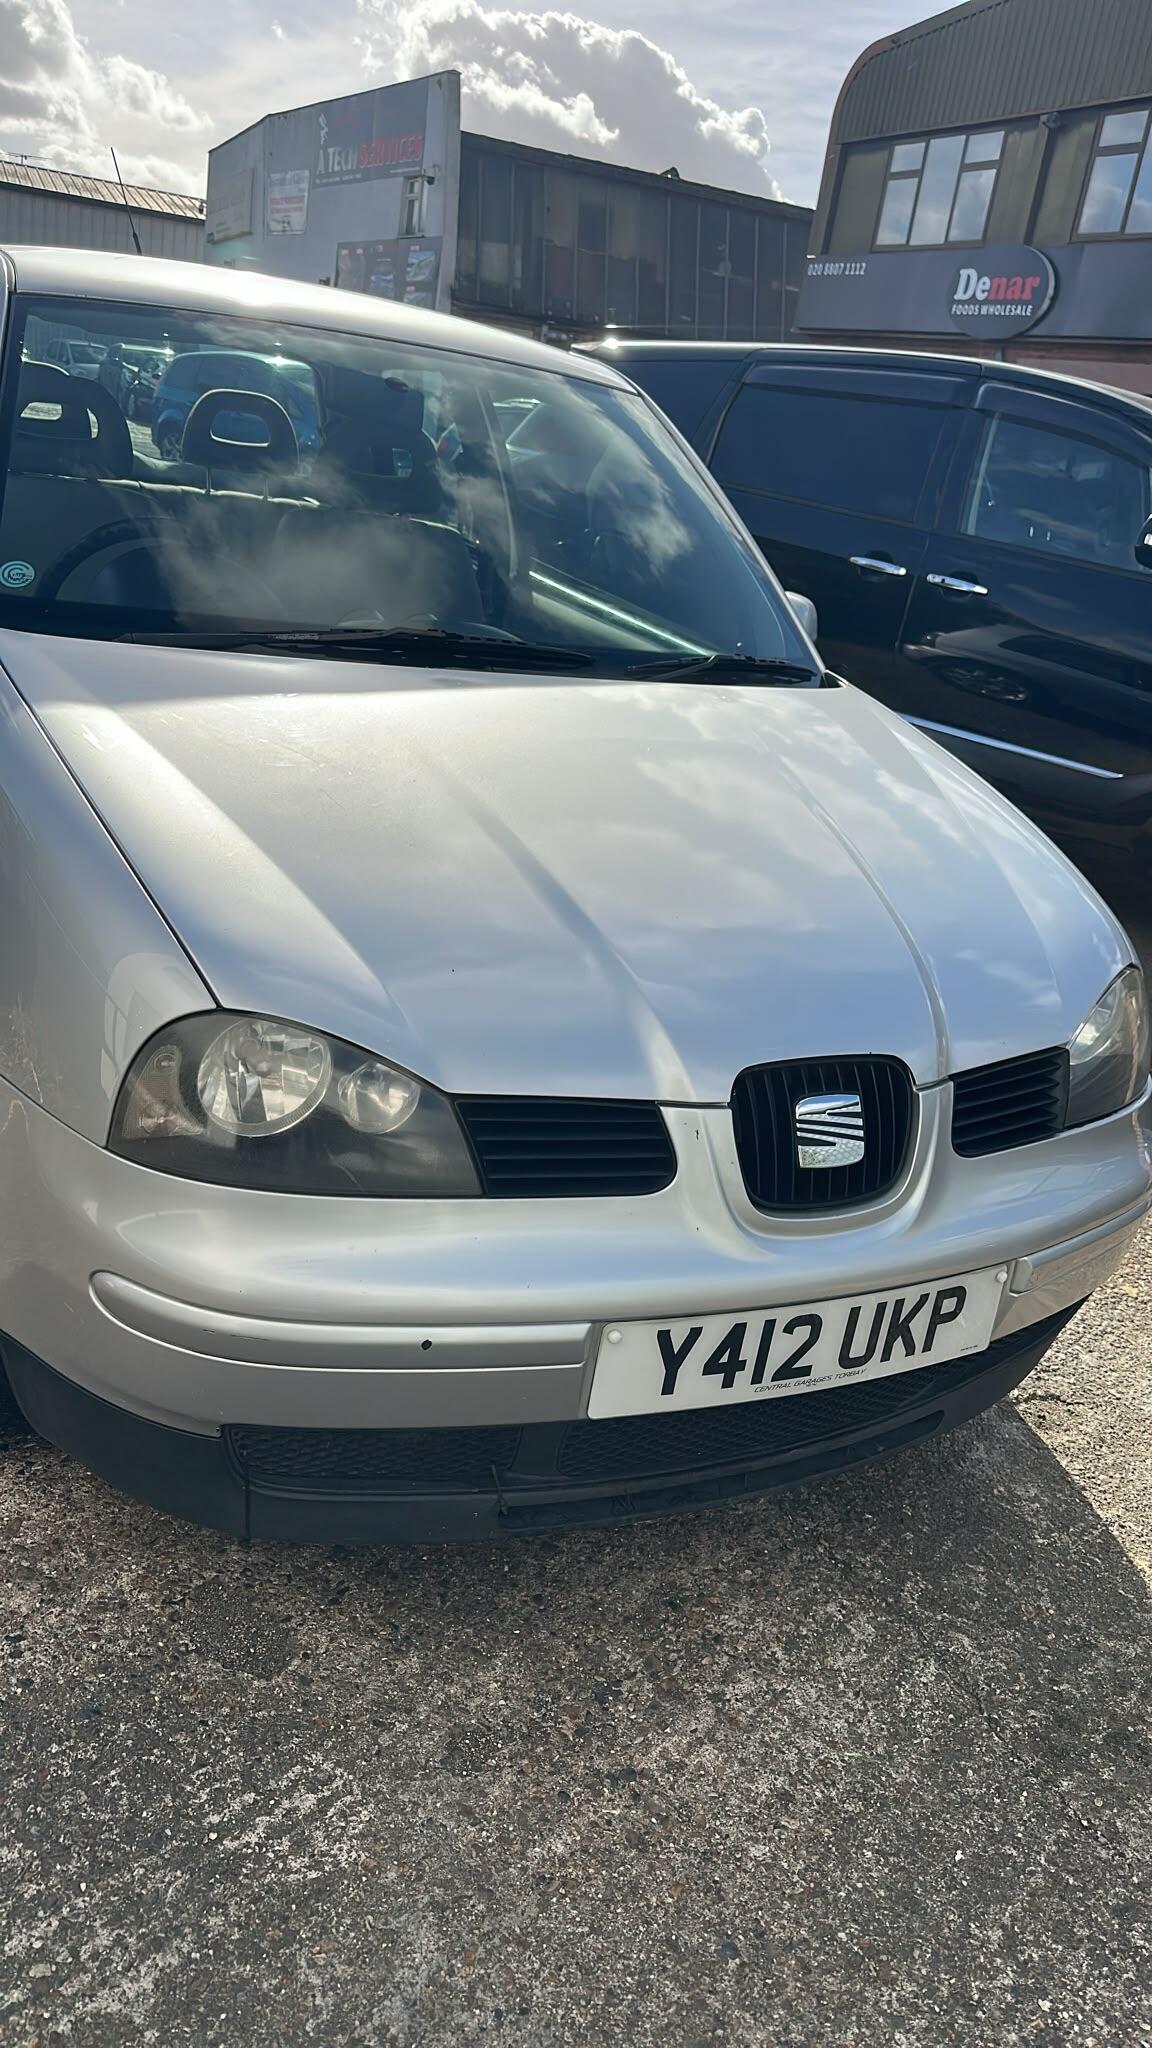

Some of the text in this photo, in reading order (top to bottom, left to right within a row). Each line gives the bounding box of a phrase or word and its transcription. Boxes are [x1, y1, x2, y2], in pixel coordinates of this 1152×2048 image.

[807, 262, 824, 276] 020
[845, 262, 867, 275] 1112
[953, 267, 1041, 301] Denar
[951, 303, 1034, 317] FOODS WHOLESALE
[656, 1285, 968, 1397] Y412 UKP
[753, 1368, 868, 1393] CENTRAL GARAGES TORBAY
